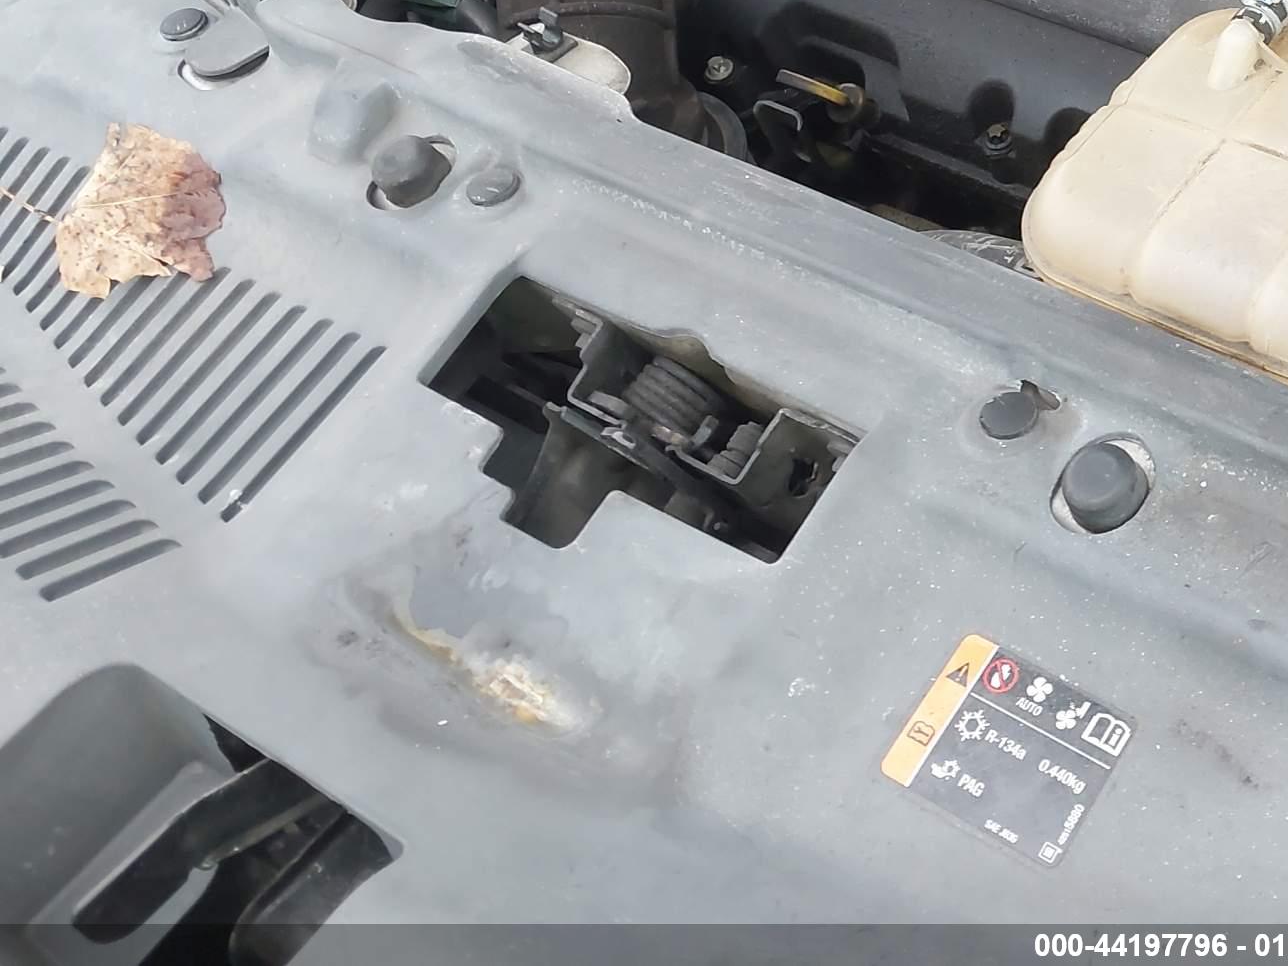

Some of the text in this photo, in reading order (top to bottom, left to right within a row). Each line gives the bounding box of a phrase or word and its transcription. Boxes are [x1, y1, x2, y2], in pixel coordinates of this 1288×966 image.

[1016, 696, 1043, 717] AUTO
[984, 728, 1028, 762] R-134a
[957, 773, 987, 798] PAG
